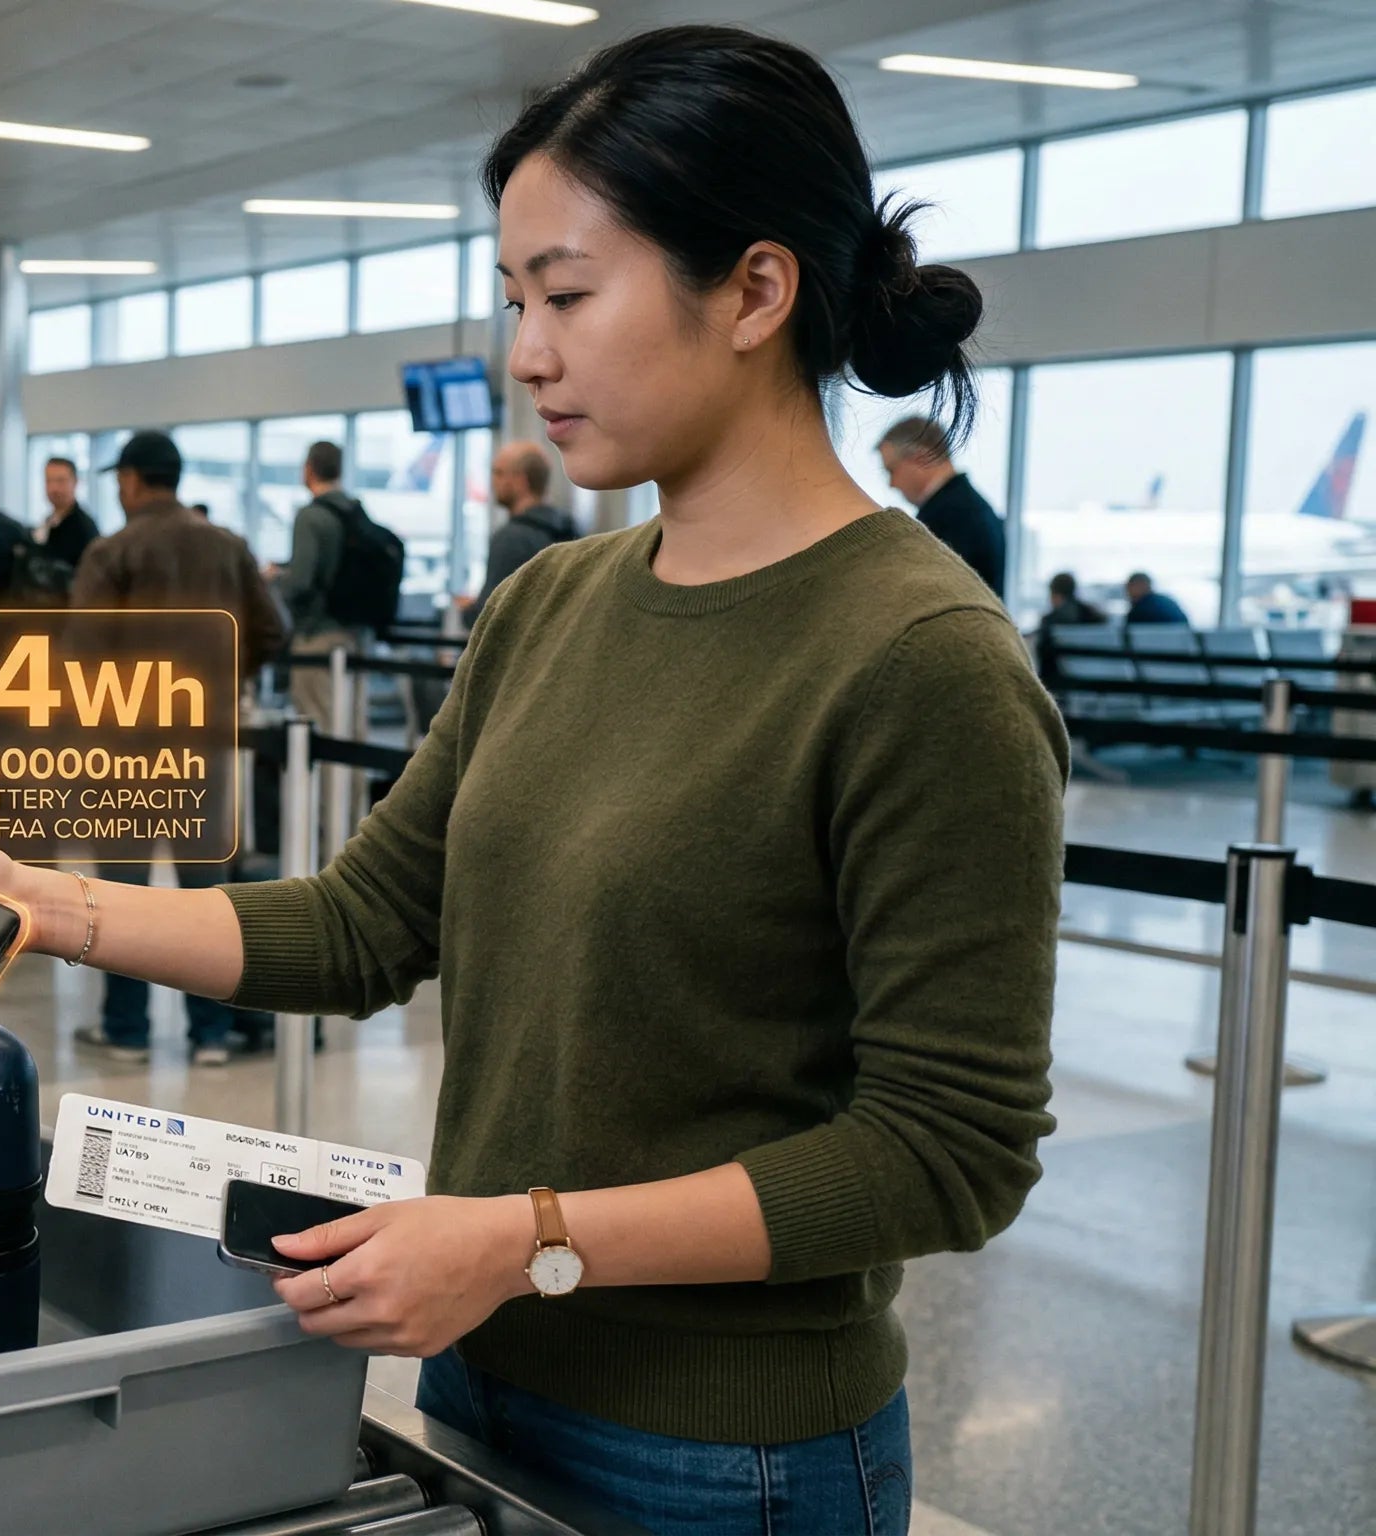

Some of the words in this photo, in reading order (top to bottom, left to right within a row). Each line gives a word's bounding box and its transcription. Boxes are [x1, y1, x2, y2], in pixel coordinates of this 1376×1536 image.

[87, 1106, 161, 1128] UNITED
[331, 1153, 385, 1170] UNITED
[267, 1173, 298, 1188] 18C
[143, 1202, 169, 1214] CHEN
